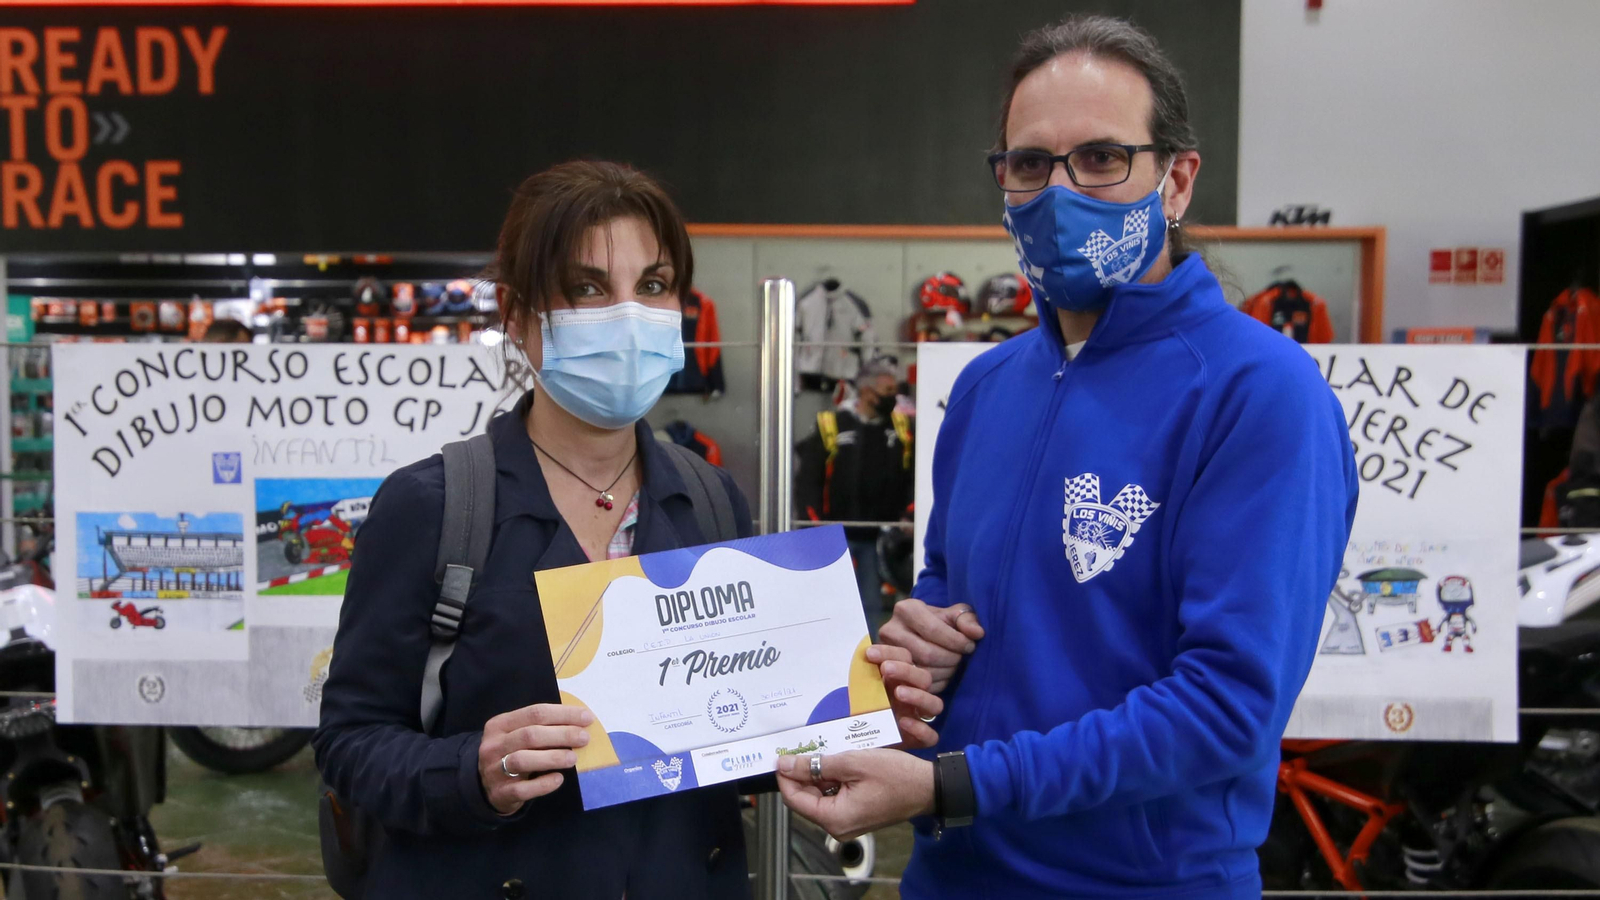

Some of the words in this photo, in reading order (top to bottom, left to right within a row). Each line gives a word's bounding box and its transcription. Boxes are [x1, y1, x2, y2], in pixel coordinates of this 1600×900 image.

[0, 27, 228, 95] READY
[0, 96, 89, 162] TO
[1, 160, 183, 229] RACE
[1102, 249, 1118, 265] LOS
[1120, 237, 1141, 252] VINIS
[91, 348, 309, 416] CONCURSO
[1315, 354, 1420, 408] LAR
[1437, 376, 1497, 425] DE
[91, 393, 226, 478] DIBUJO
[246, 396, 369, 428] MOTO
[394, 397, 442, 432] GP
[1073, 508, 1096, 520] LOS
[1098, 511, 1126, 532] VINIS
[1069, 543, 1084, 577] JEREZ
[654, 580, 755, 627] DIPLOMA
[670, 622, 704, 633] CONCURSO
[704, 618, 727, 627] DIBUJO
[728, 613, 756, 623] ESCOLAR
[607, 648, 635, 657] COLEGIO:
[682, 640, 781, 685] Premio
[716, 703, 739, 715] 2021
[851, 729, 881, 739] Motorista
